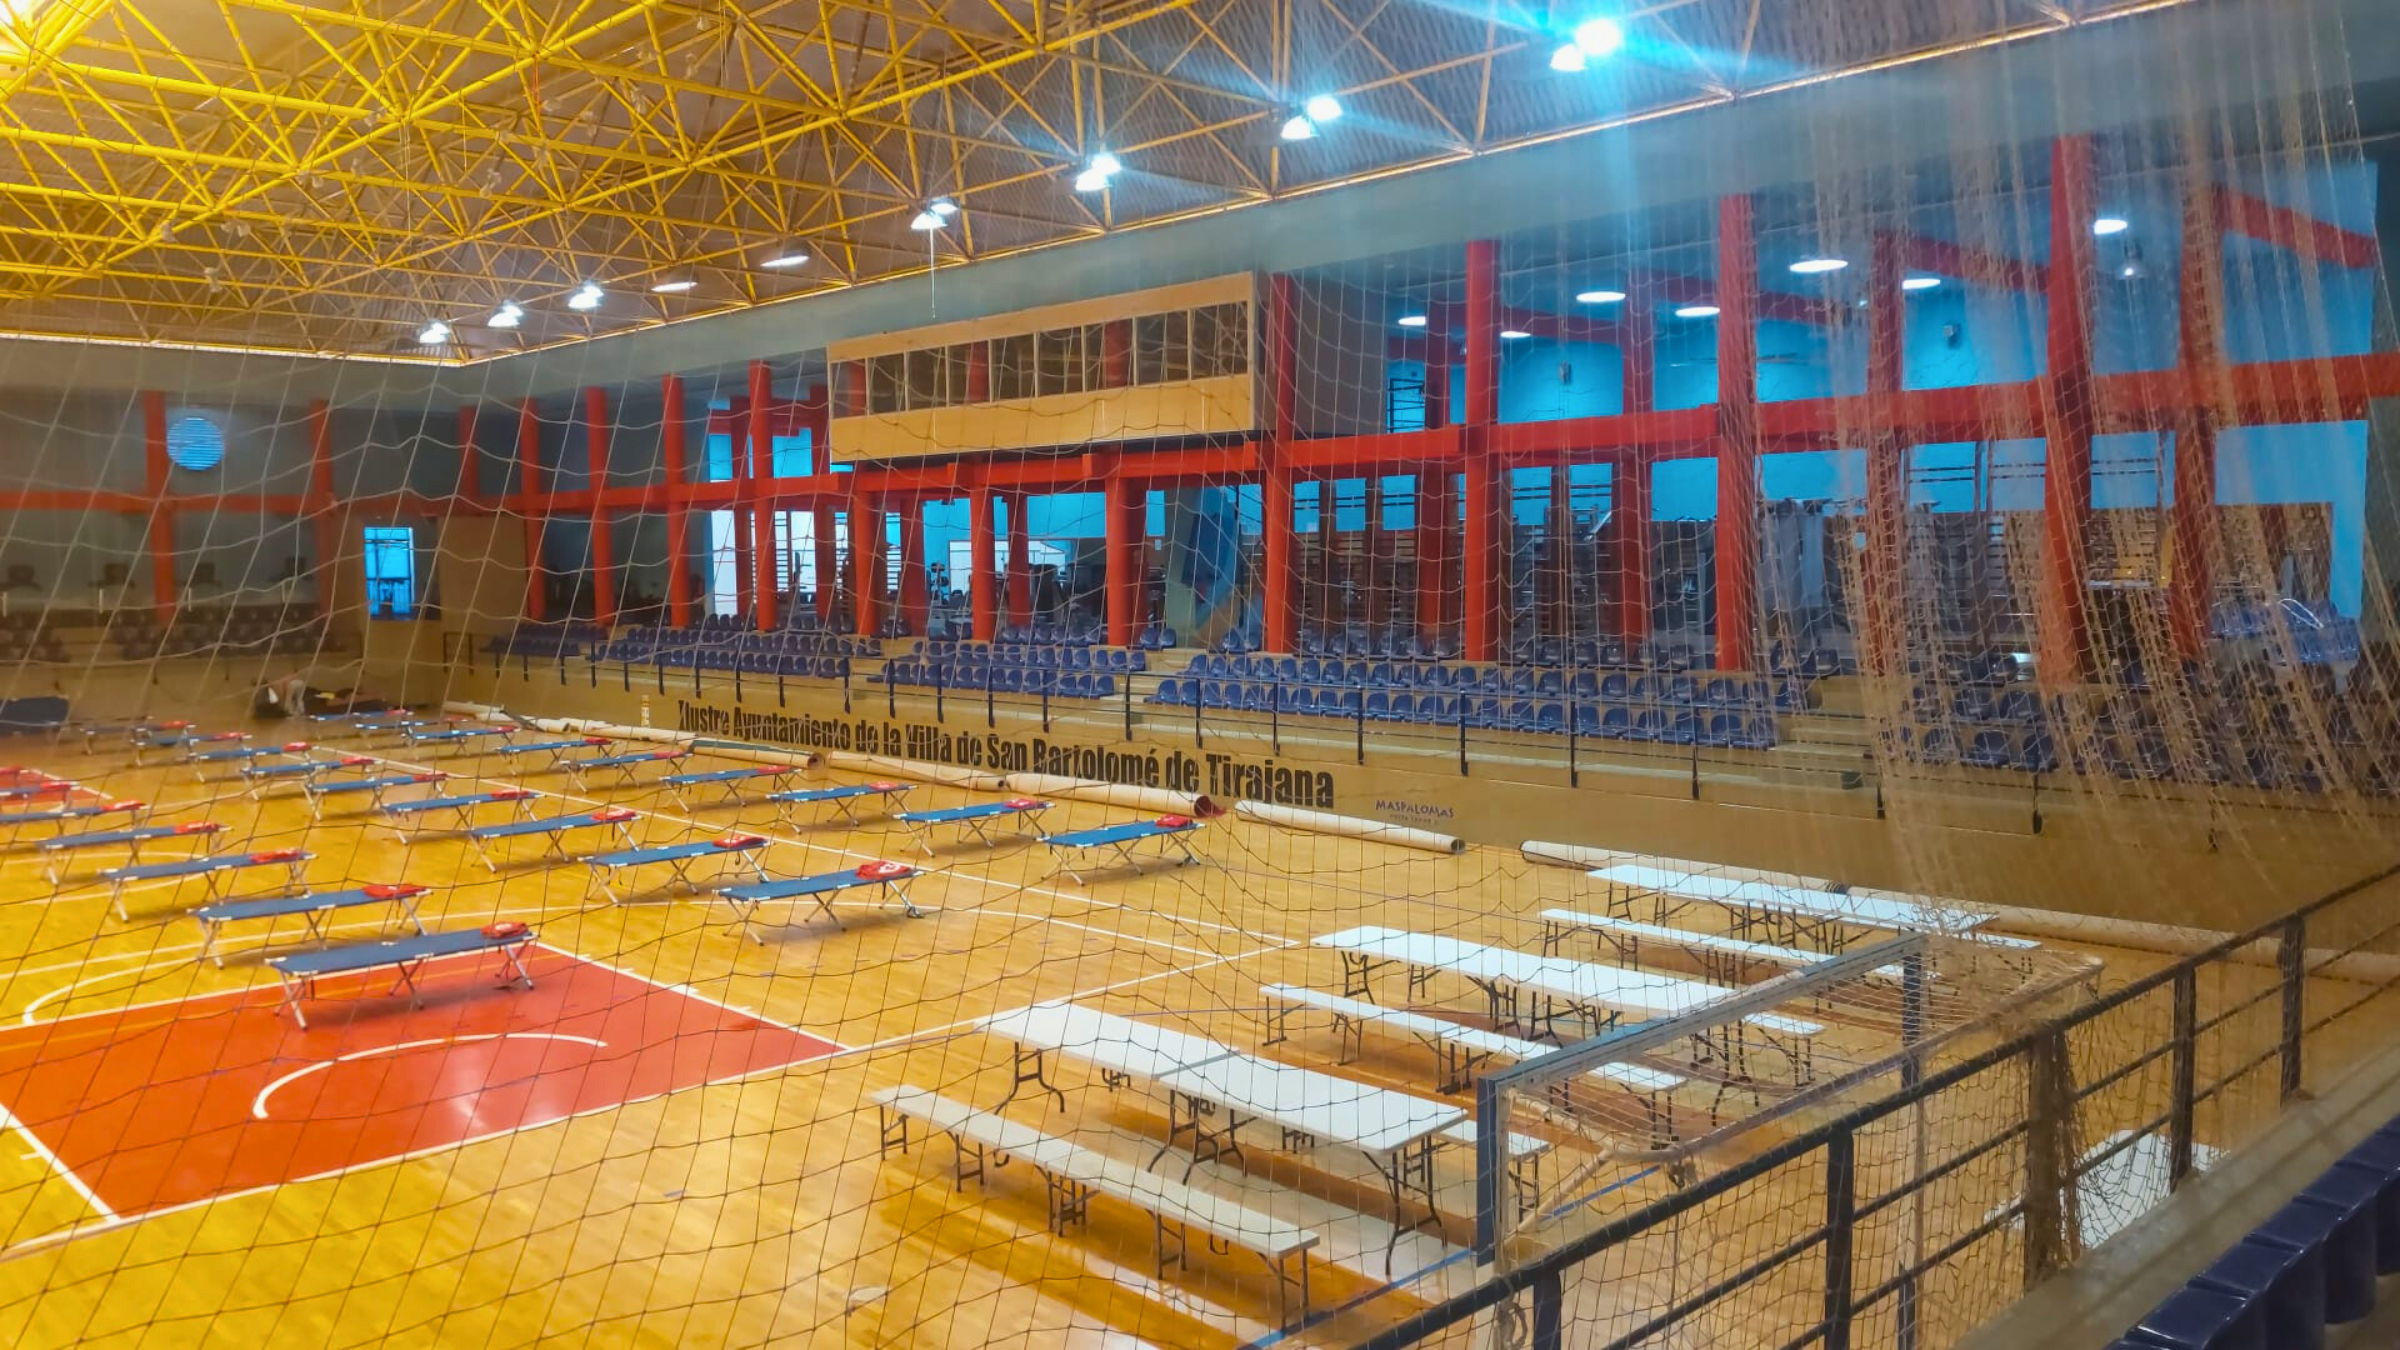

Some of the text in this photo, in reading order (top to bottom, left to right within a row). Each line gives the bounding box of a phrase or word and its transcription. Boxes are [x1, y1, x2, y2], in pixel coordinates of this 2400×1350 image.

[678, 700, 1334, 809] Ilustre Ayuntamiento de la Villa de San Bartolomé de Tirajana
[1375, 799, 1454, 819] MASPALOMAS
